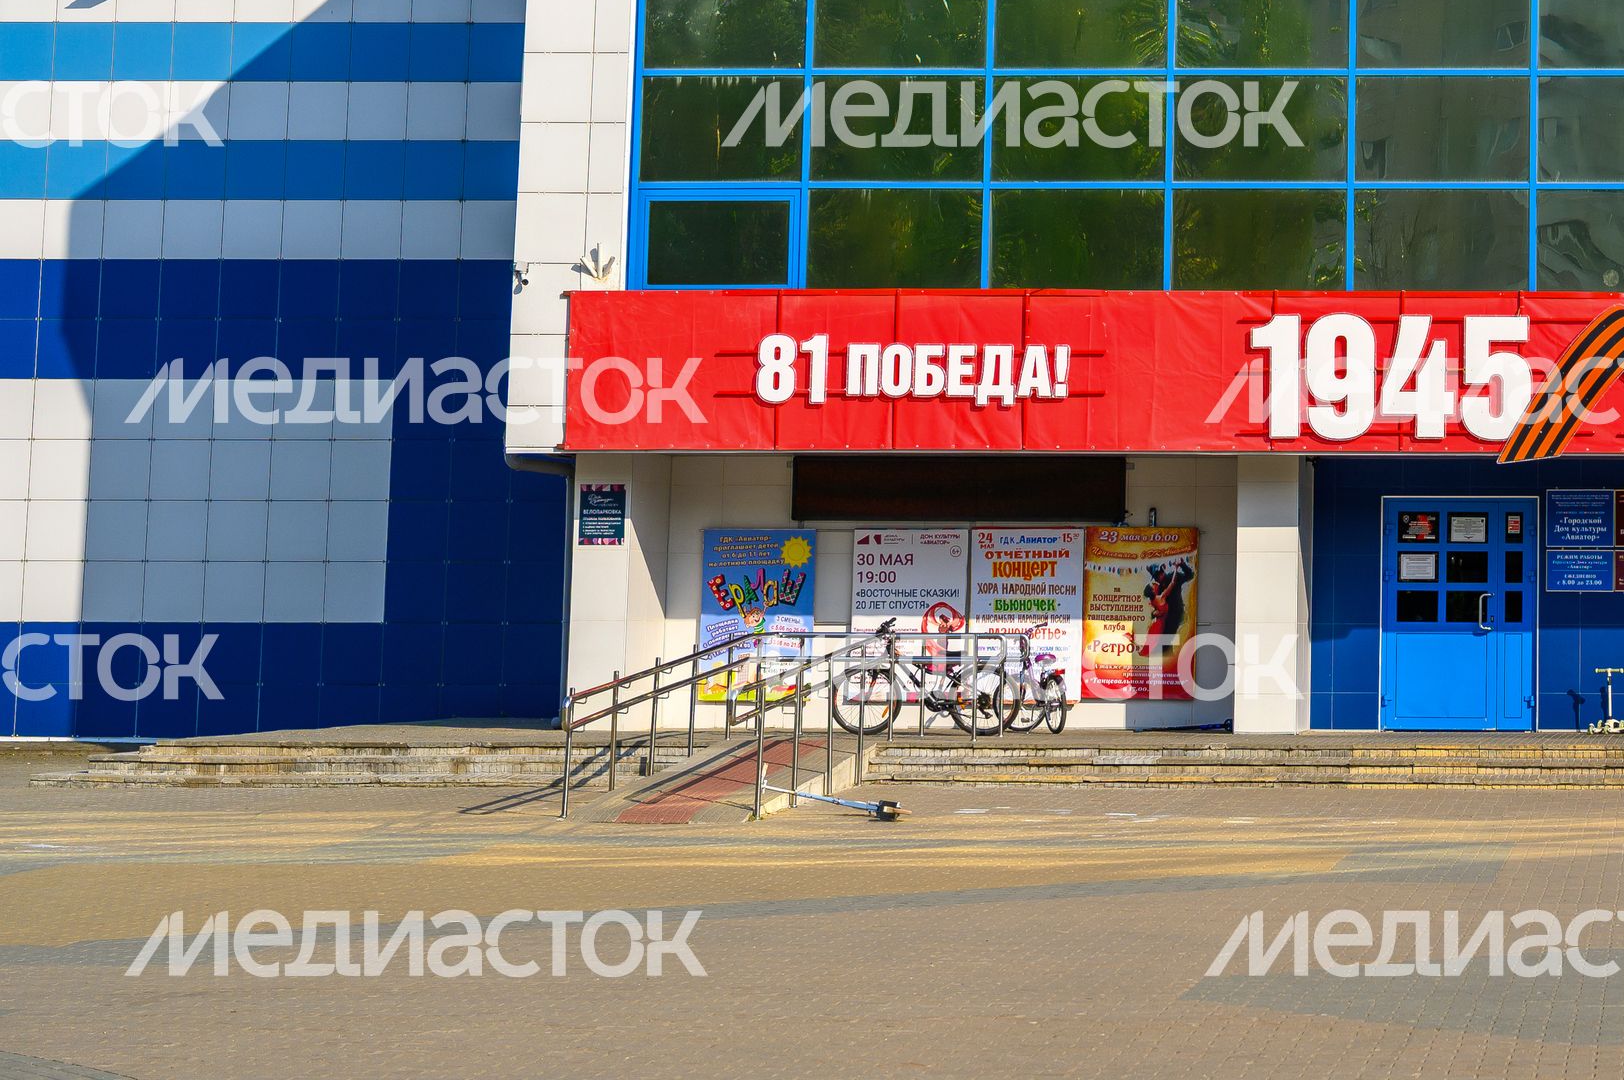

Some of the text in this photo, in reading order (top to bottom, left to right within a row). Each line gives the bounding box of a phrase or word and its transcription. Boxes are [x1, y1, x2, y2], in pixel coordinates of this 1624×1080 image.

[756, 334, 1071, 406] 81 ПОБЕДА!
[1250, 313, 1531, 442] 1945
[978, 533, 992, 544] 24
[1000, 537, 1015, 545] ГДК
[1100, 531, 1118, 543] 23
[985, 548, 1070, 559] ОТЧЁТНЫЙ
[857, 554, 913, 565] 30 МАЯ
[857, 571, 896, 583] 19:00
[856, 589, 959, 597] «ВОСТОЧНЫЕ СКАЗКИ!
[977, 583, 999, 594] ХОРА
[1002, 582, 1046, 596] НАРОДНОЙ
[1093, 594, 1141, 602] КОНЦЕРТНОЕ
[856, 601, 929, 609] 20 ЛЕТ СПУСТЯ»
[1104, 623, 1125, 632] клуба
[1088, 640, 1140, 656] «Ретро»
